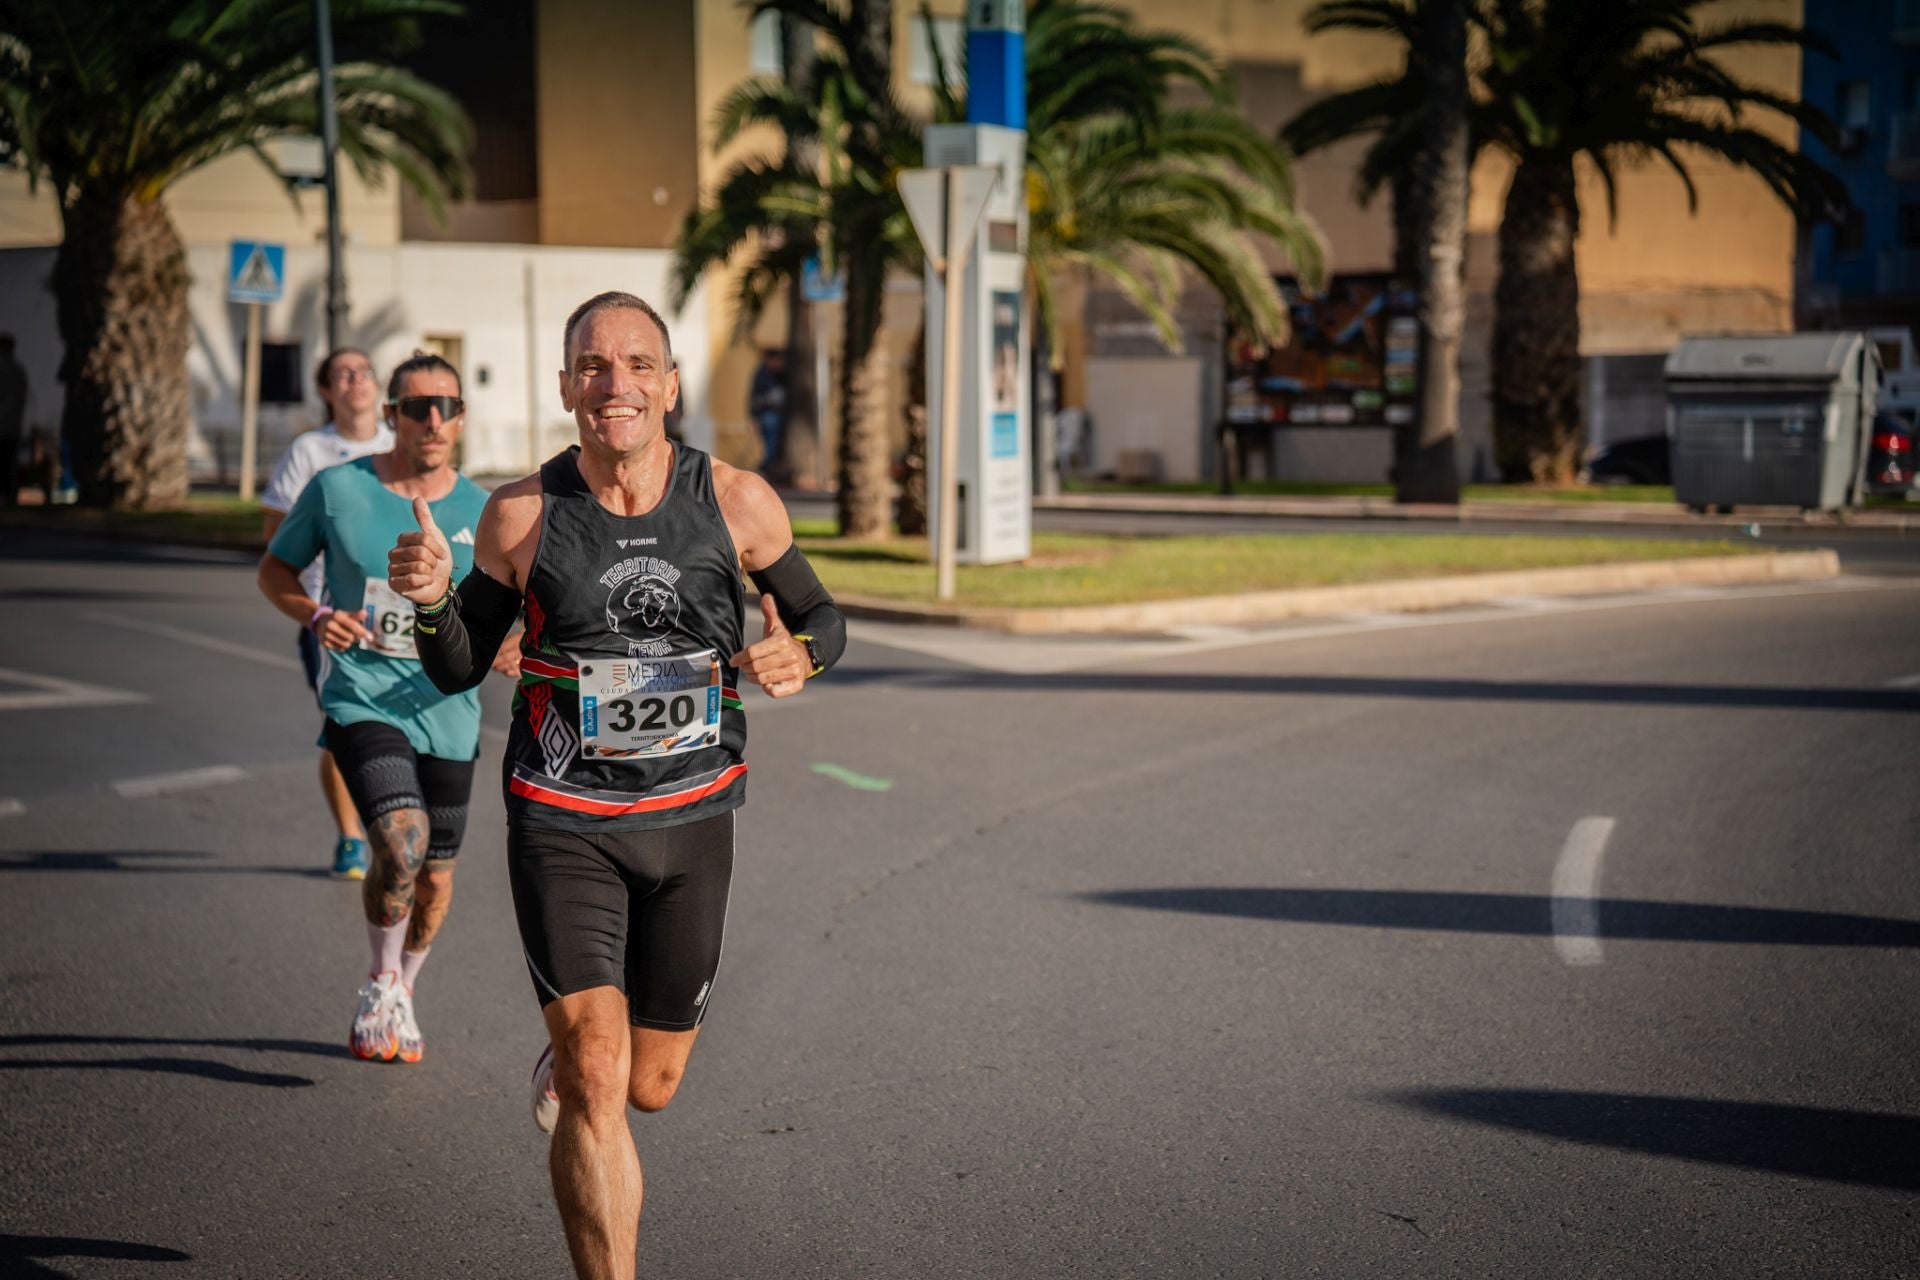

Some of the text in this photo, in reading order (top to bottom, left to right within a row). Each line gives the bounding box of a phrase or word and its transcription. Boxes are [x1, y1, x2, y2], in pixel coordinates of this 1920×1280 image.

[630, 538, 657, 546] HORME
[600, 557, 681, 589] TERRITORIO
[627, 662, 678, 678] MEDIA
[608, 695, 695, 732] 320
